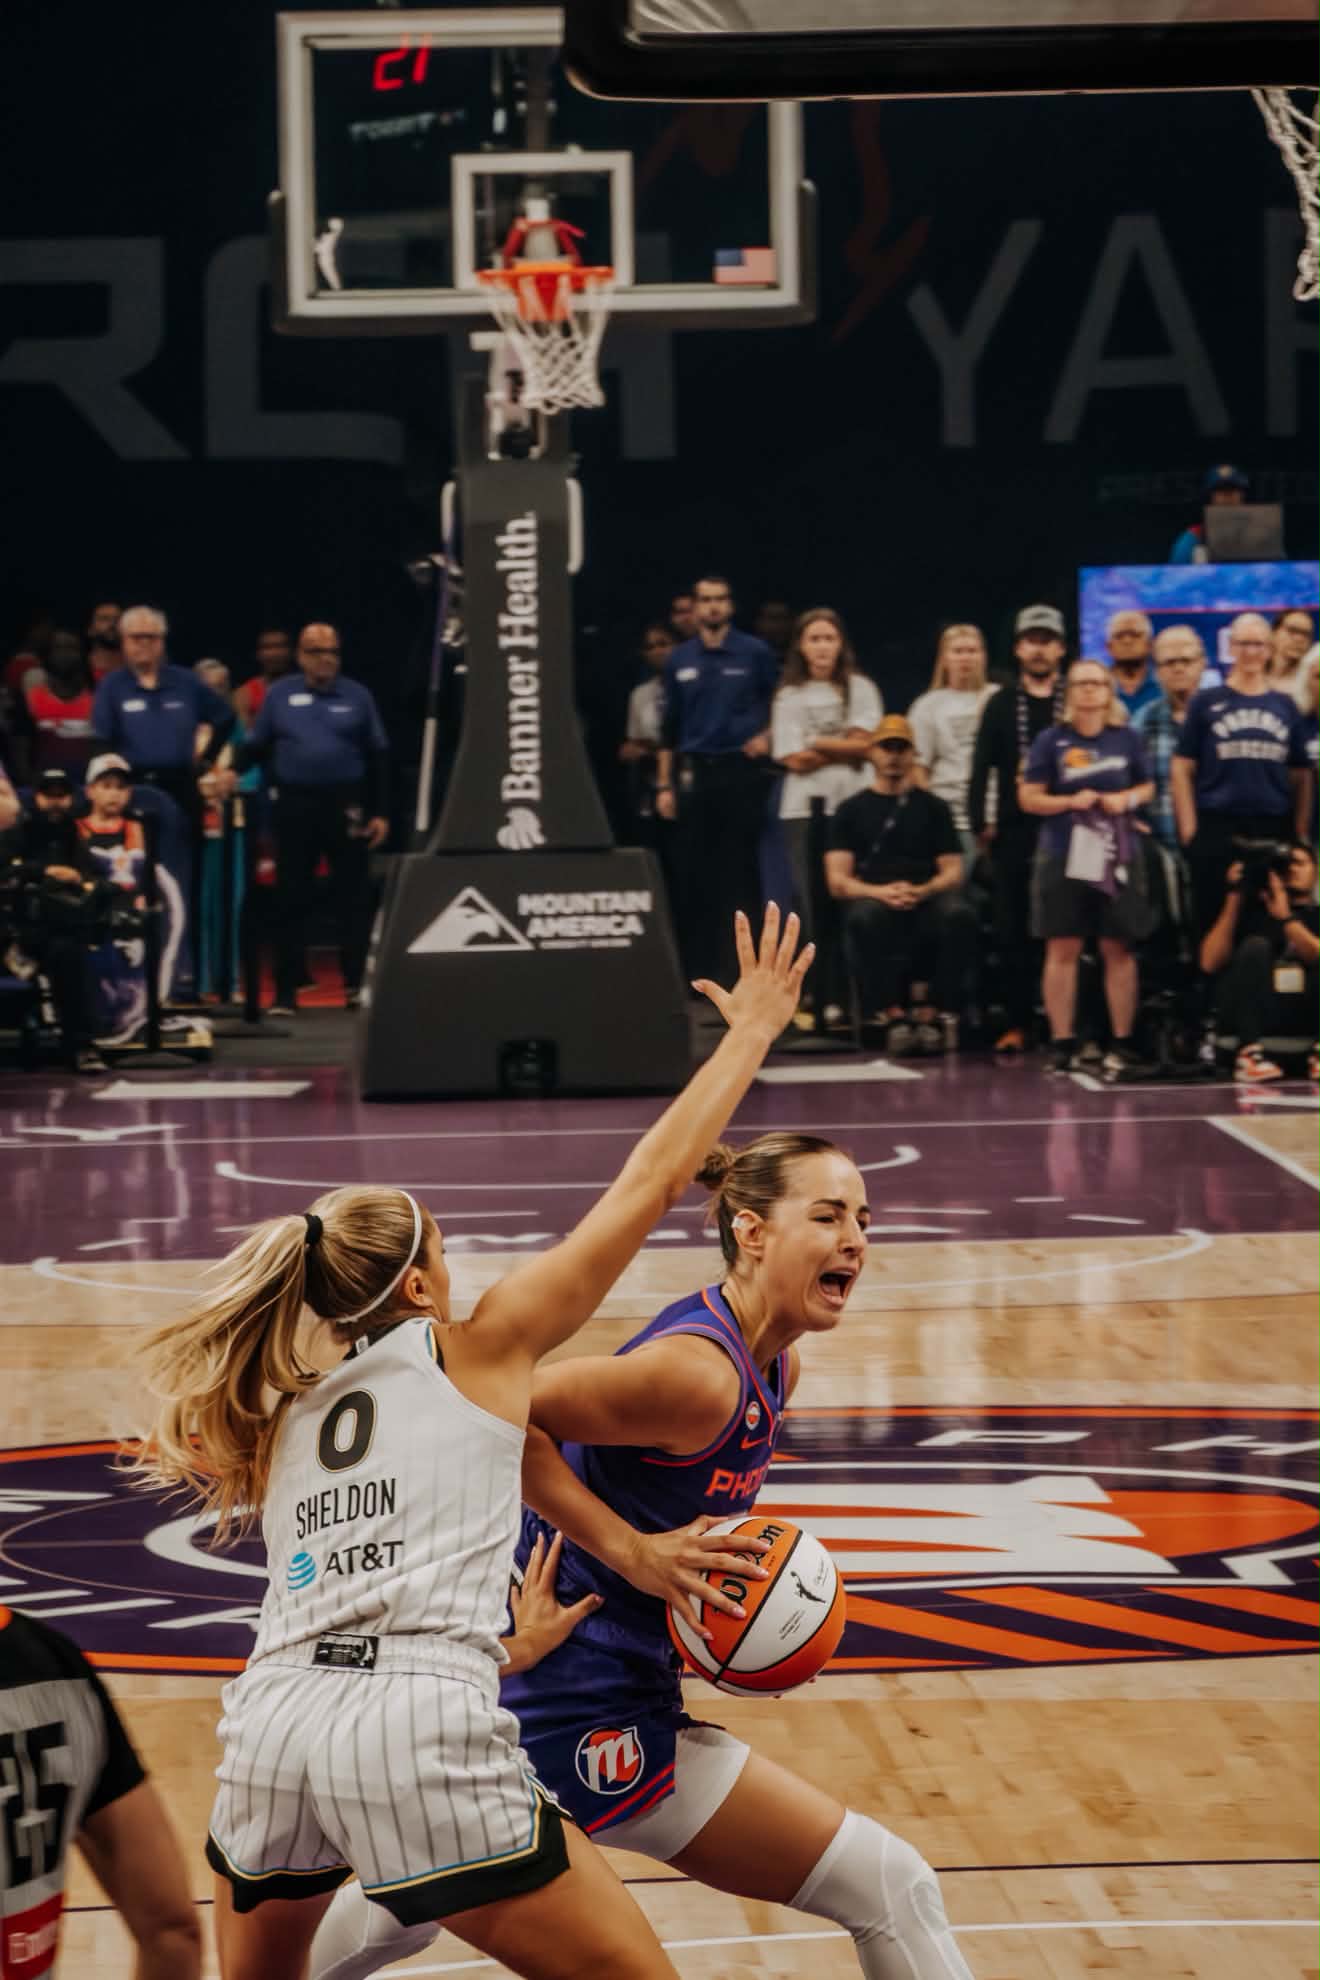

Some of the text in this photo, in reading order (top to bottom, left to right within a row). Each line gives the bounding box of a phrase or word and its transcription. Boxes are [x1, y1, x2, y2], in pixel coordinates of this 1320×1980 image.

[373, 31, 432, 90] 21
[495, 516, 541, 802] Banner Health
[517, 889, 652, 916] MOUNTAIN
[526, 913, 644, 938] AMERICA
[316, 1387, 378, 1474] 0
[296, 1477, 397, 1540] SHELDON
[322, 1539, 405, 1577] AT&T
